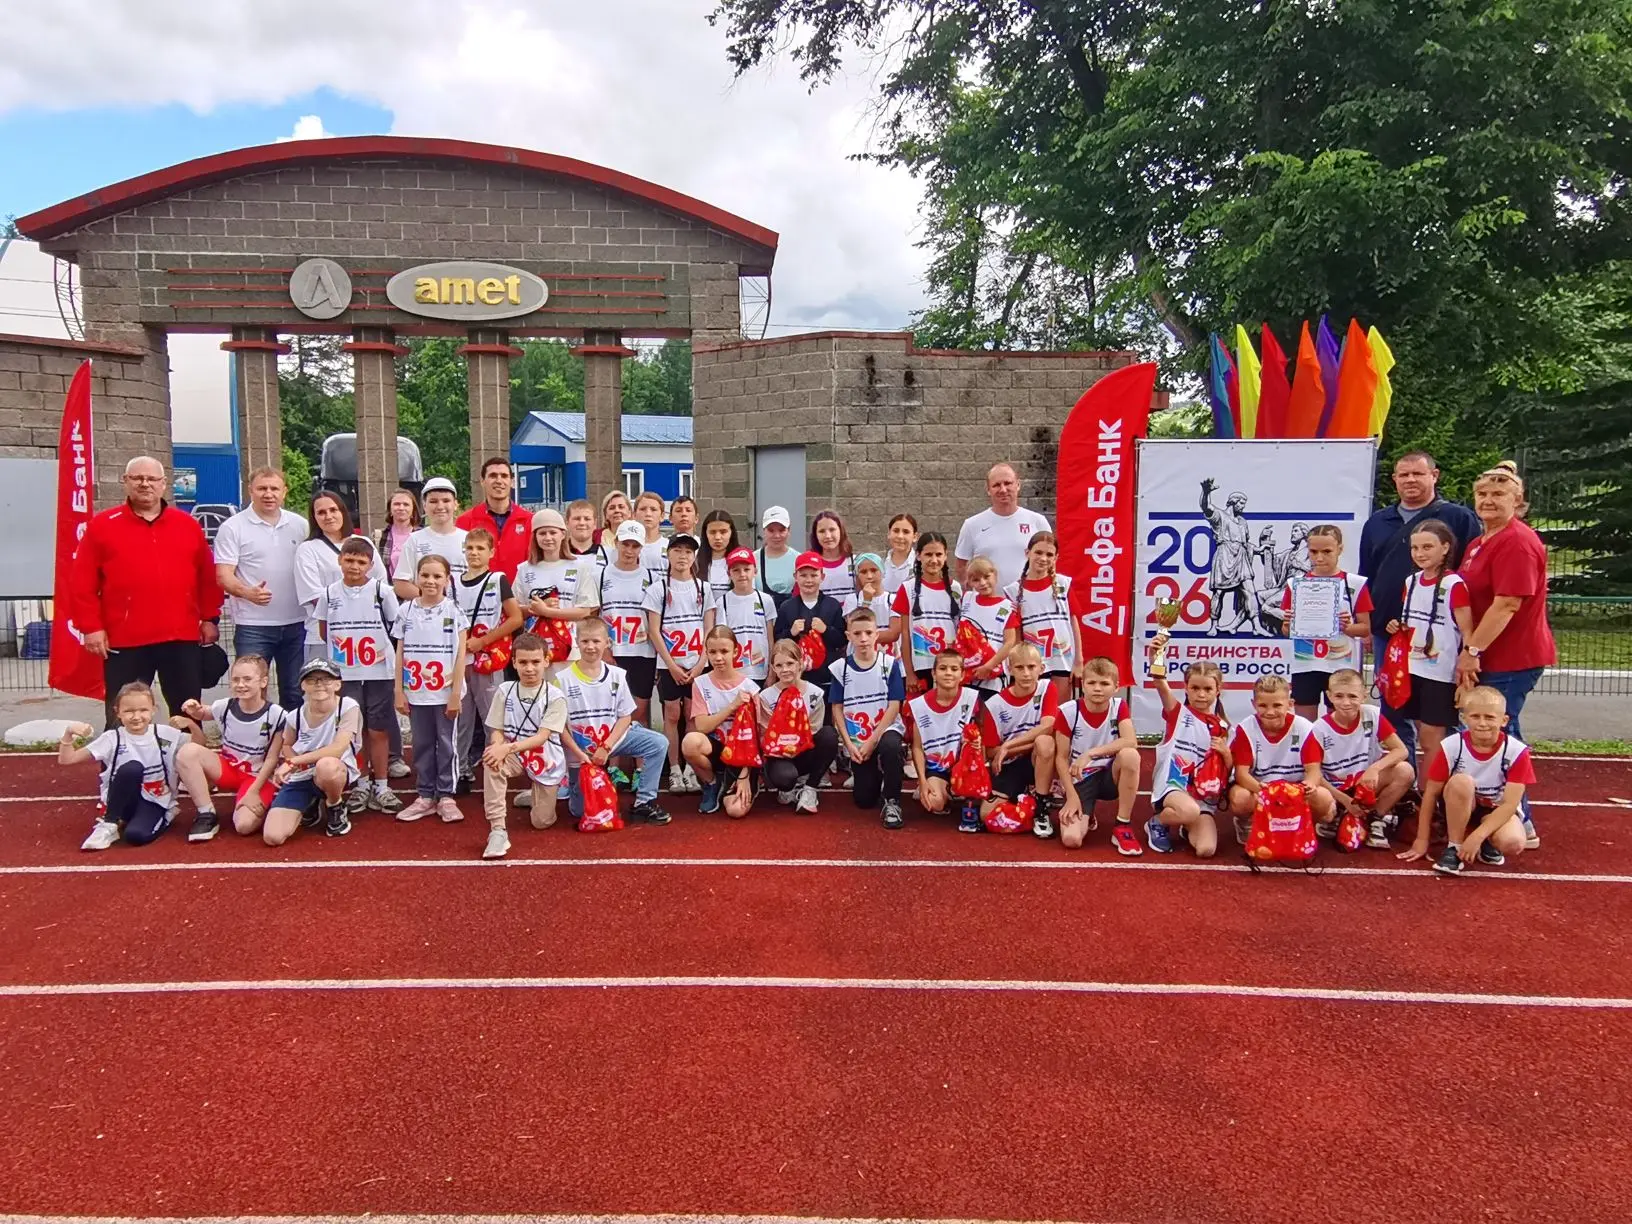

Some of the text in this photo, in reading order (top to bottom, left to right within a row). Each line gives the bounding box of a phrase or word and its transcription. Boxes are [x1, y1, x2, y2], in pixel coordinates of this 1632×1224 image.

[414, 274, 521, 307] amet
[1082, 418, 1126, 636] Альфа Банк
[1148, 525, 1214, 575] 20
[611, 616, 641, 645] 17
[669, 628, 703, 657] 24
[927, 626, 947, 656] 3
[1037, 628, 1055, 658] 7
[340, 636, 377, 667] 16
[1187, 645, 1282, 660] ЕДИНСТВА
[406, 660, 445, 691] 33
